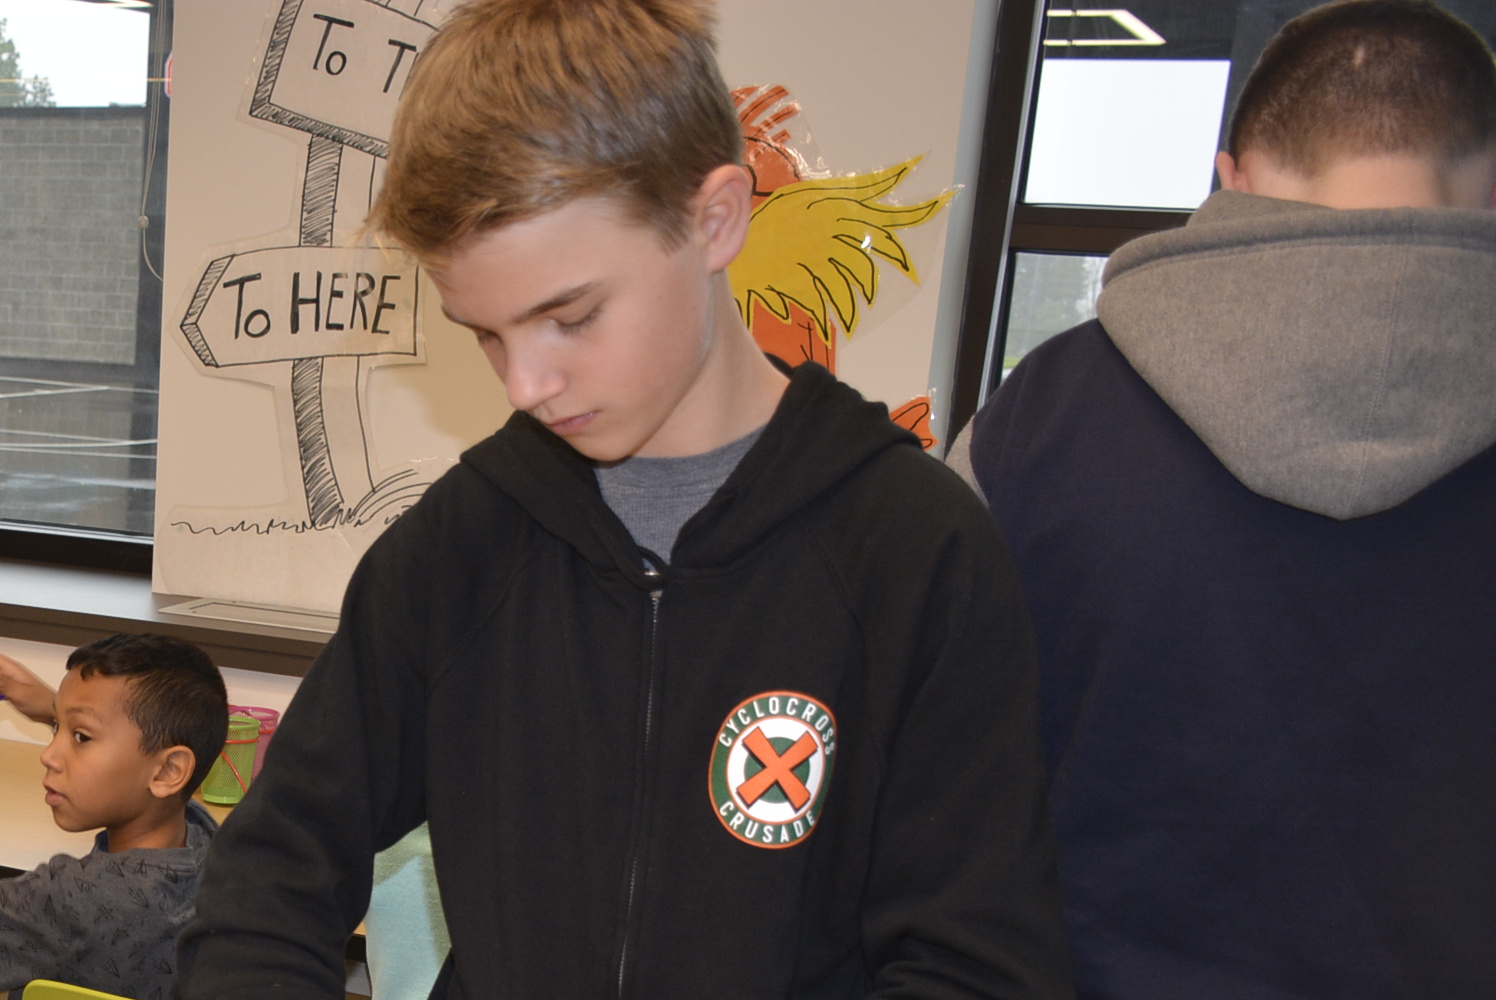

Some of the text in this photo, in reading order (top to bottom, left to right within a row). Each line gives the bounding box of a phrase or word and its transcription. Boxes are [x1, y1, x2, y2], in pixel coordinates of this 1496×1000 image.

[312, 13, 355, 76] To
[222, 270, 402, 340] To HERE
[718, 696, 836, 756] CYCLOCROSS
[718, 800, 817, 844] CRUSADE
